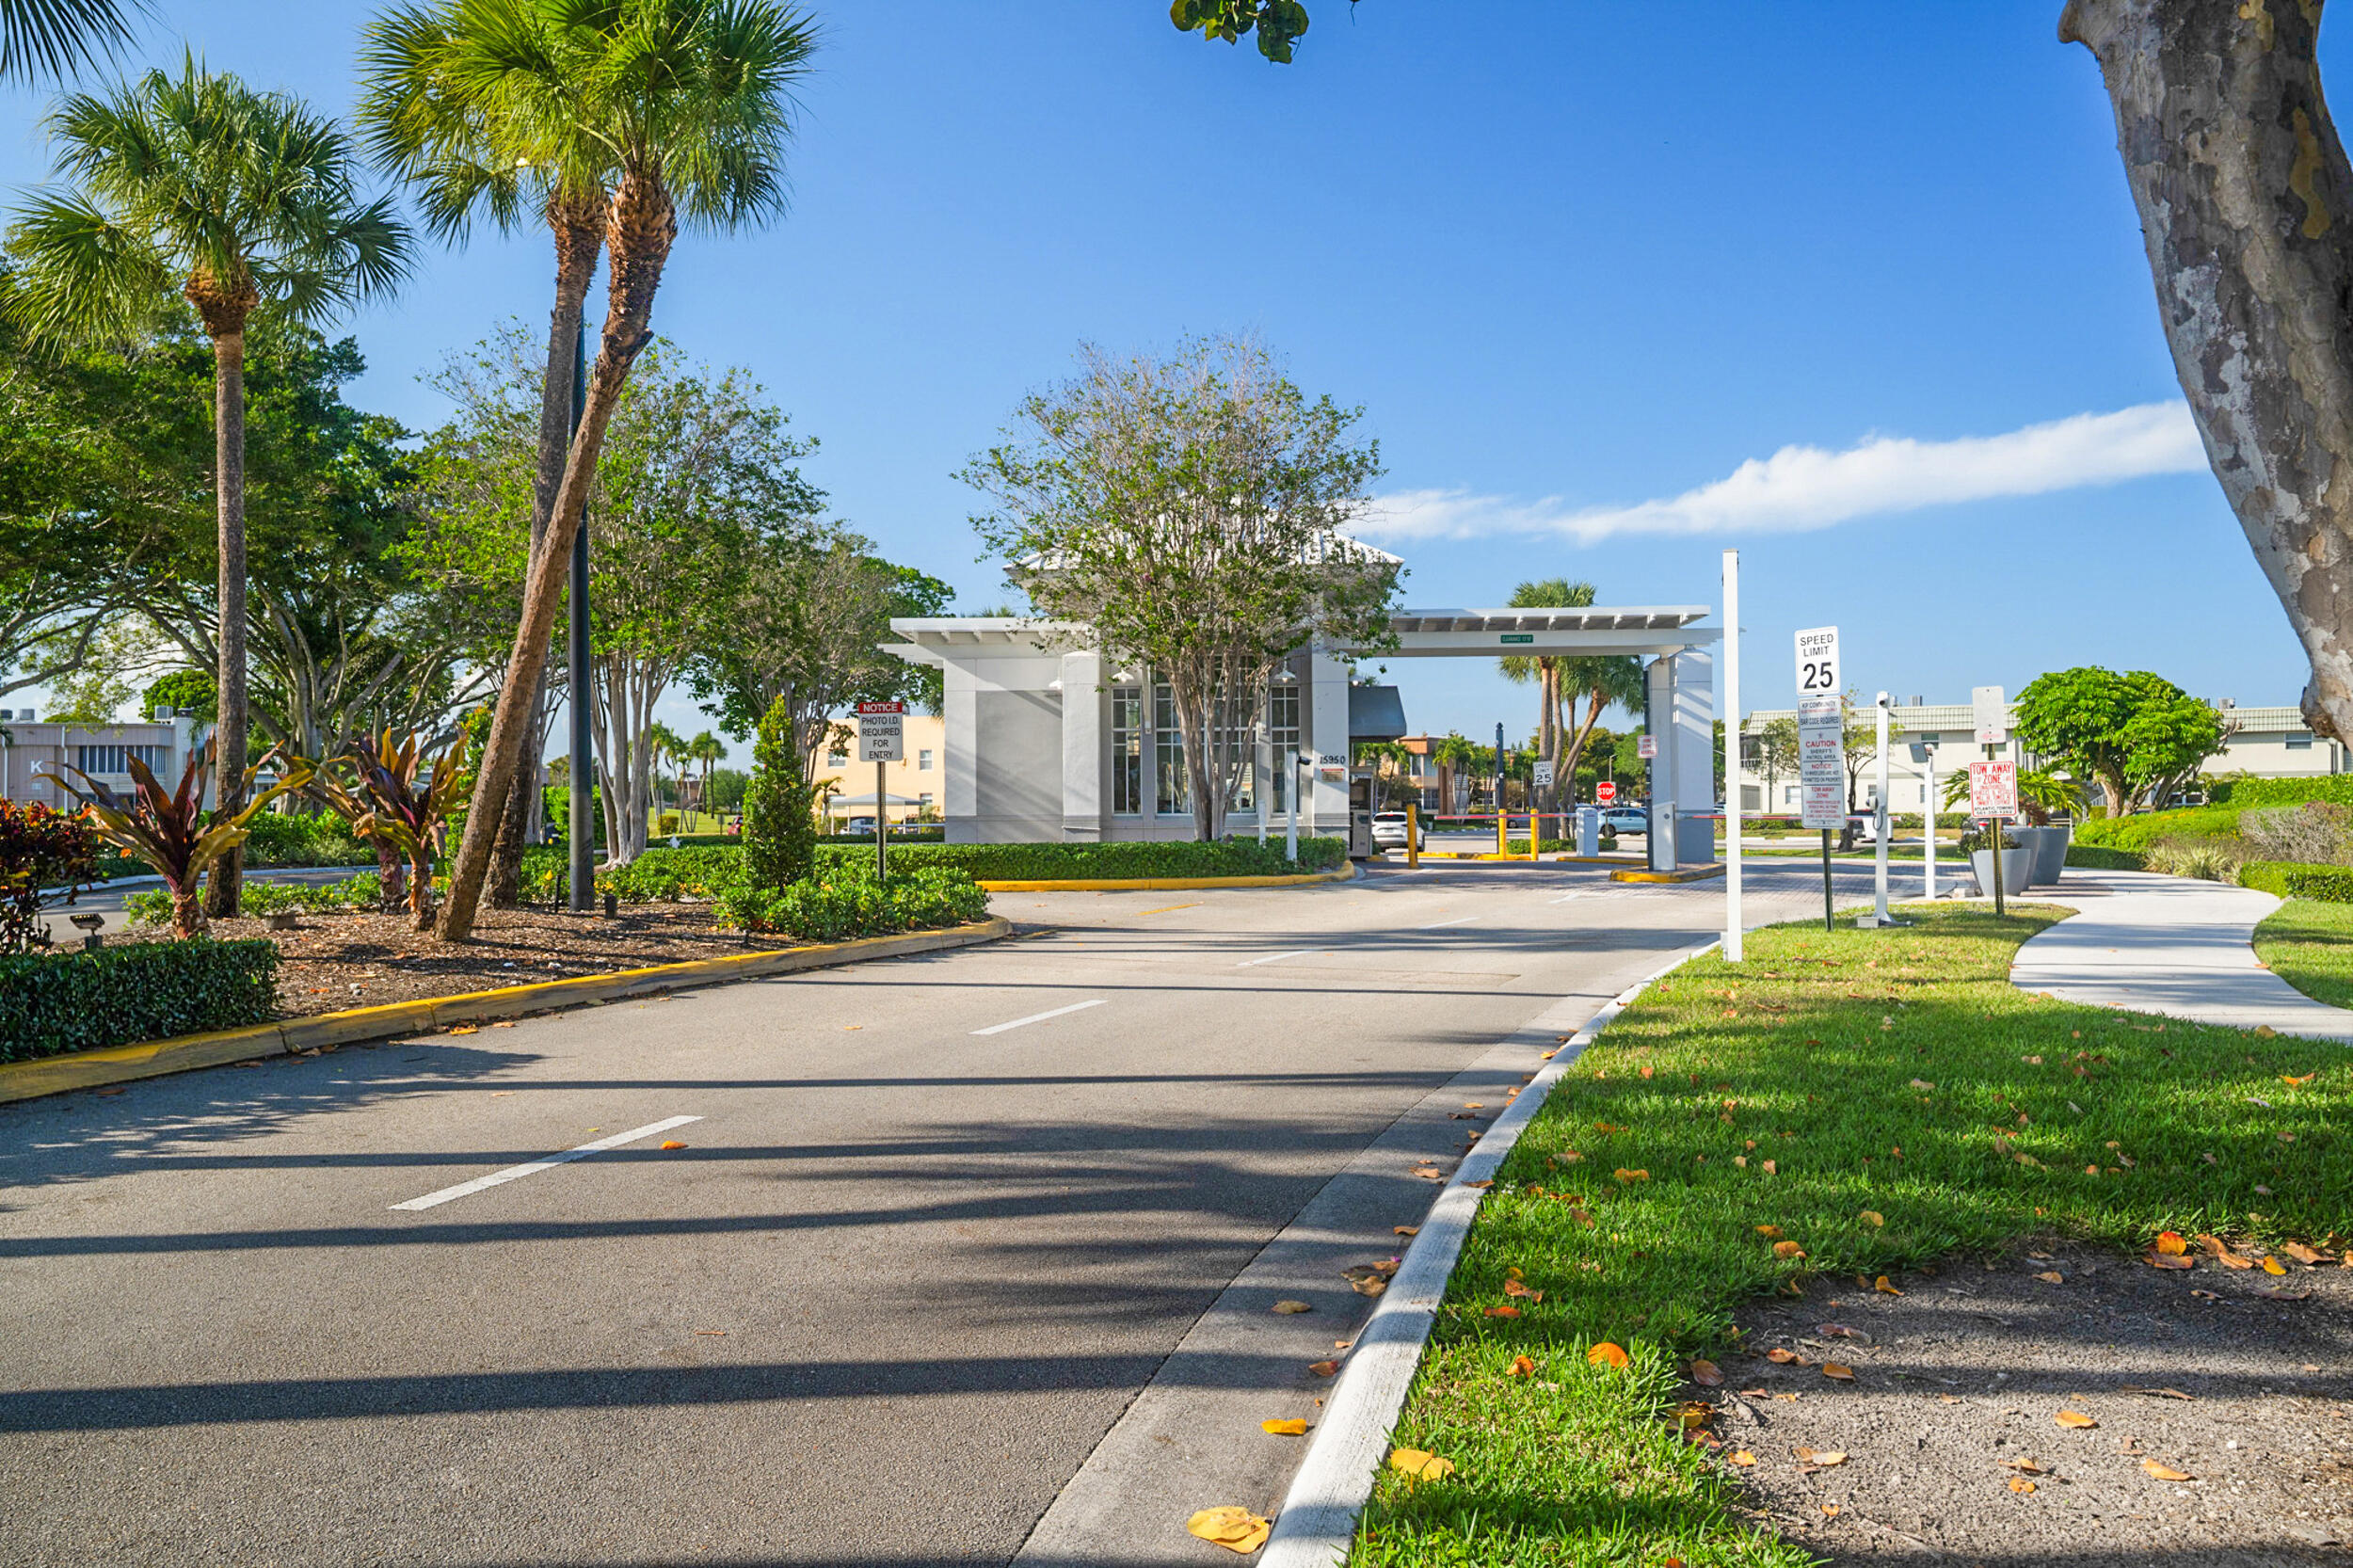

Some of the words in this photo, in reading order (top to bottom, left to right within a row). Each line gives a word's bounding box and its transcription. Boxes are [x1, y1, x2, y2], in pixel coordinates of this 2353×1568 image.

[1800, 633, 1833, 647] SPEED
[1803, 646, 1830, 657] LIMIT
[1803, 662, 1833, 689] 25
[863, 703, 898, 712] NOTICE
[861, 716, 888, 725] PHOTO
[1819, 715, 1839, 724] REQUIRED
[862, 728, 900, 736] REQUIRED
[872, 739, 889, 747] FOR
[869, 750, 893, 760] ENTRY
[1320, 755, 1346, 764] 15950
[30, 760, 43, 774] K
[1973, 764, 1987, 775] TOW
[1993, 763, 2011, 774] AWAY
[1536, 774, 1552, 783] 25
[1983, 774, 2002, 784] ZONE
